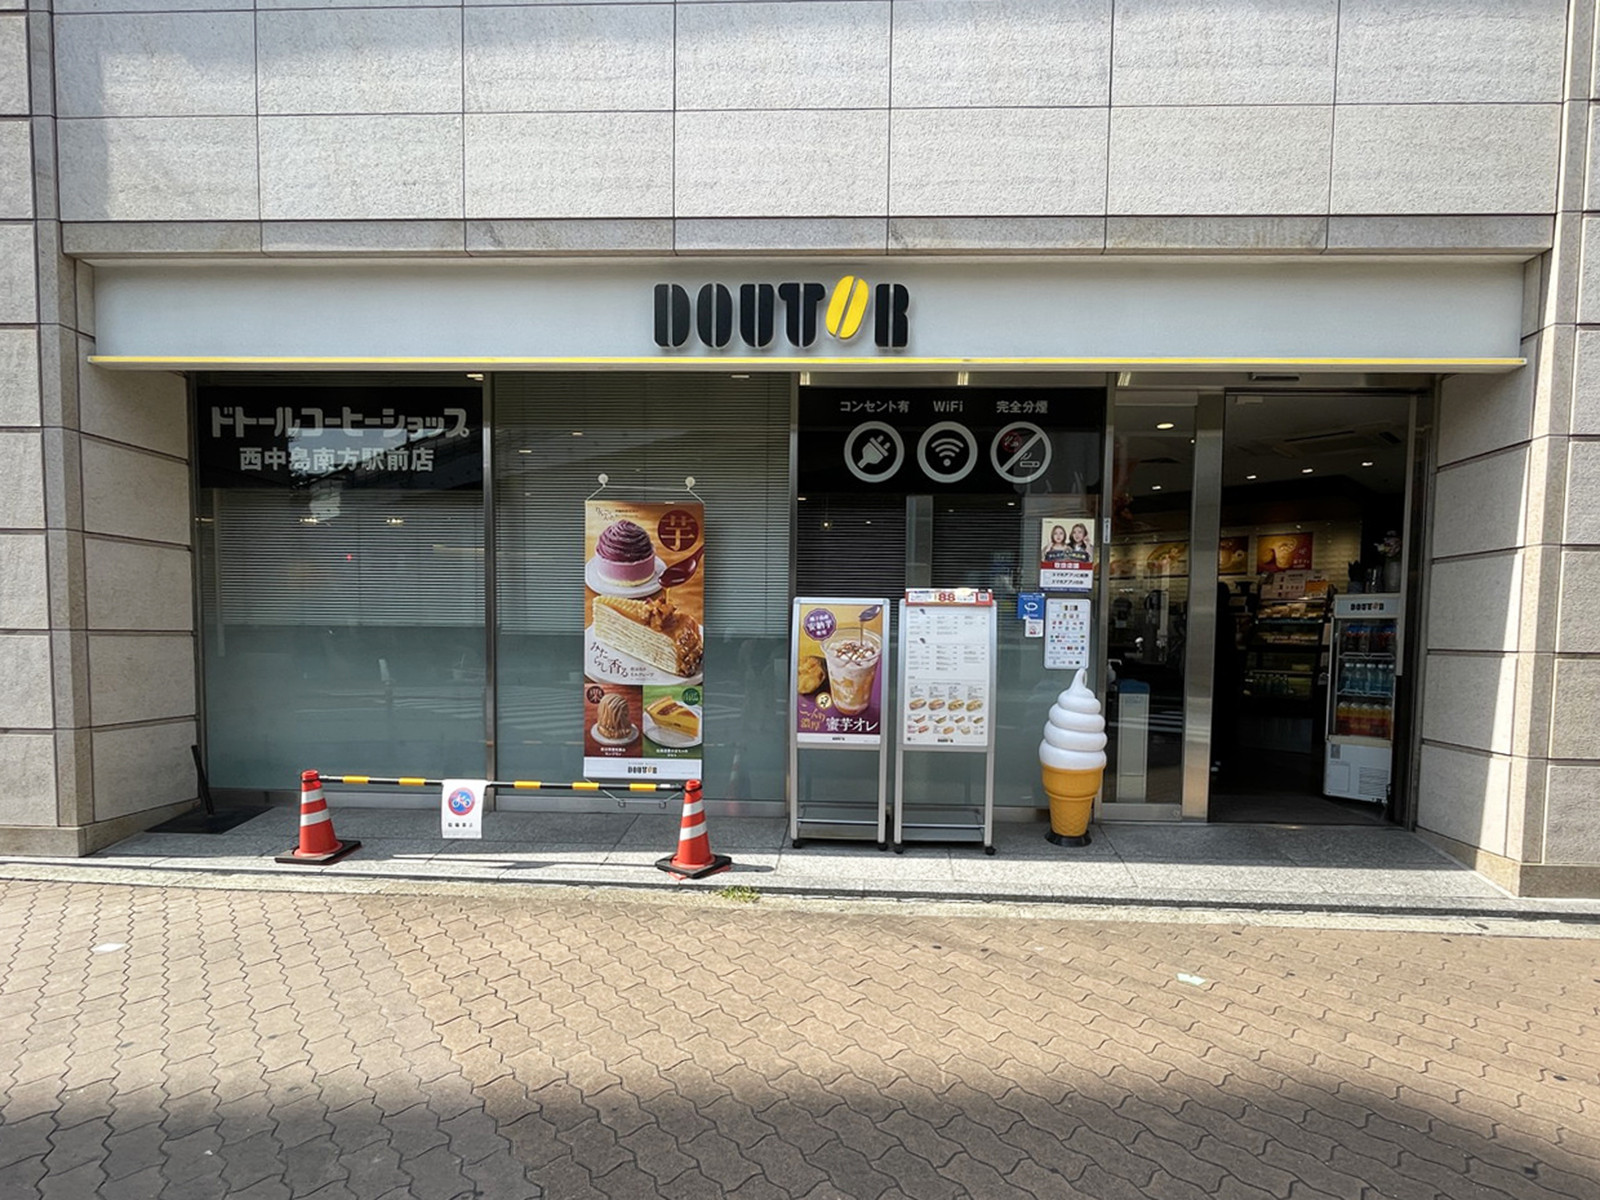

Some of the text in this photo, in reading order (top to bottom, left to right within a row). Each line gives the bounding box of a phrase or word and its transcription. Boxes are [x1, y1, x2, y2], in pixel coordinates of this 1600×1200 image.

[653, 275, 910, 349] DOUTOR
[839, 400, 910, 413] コンセント有
[933, 400, 964, 413] WiFi
[996, 400, 1049, 414] 完全分煙
[210, 406, 470, 438] ドトールコーヒーショップ
[239, 446, 435, 472] 西中島南方駅前店
[661, 515, 695, 551] 芋
[825, 716, 879, 732] 蜜芋オレ
